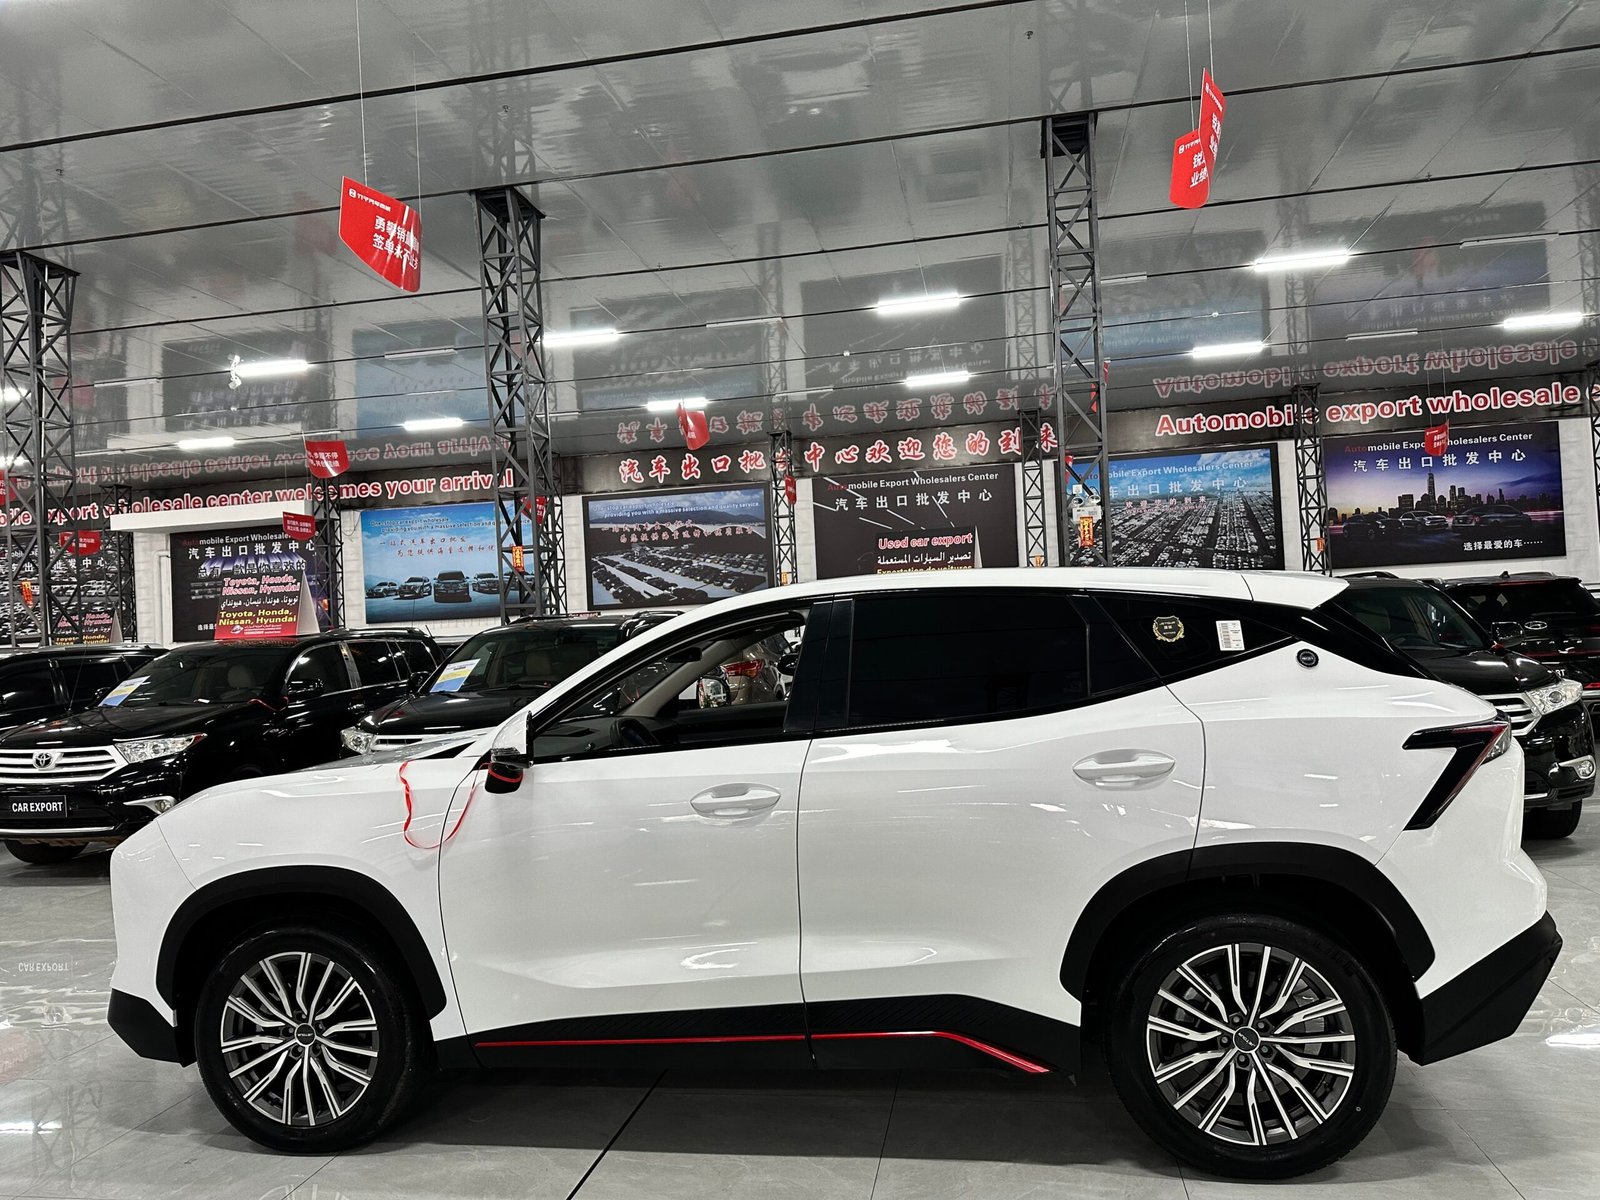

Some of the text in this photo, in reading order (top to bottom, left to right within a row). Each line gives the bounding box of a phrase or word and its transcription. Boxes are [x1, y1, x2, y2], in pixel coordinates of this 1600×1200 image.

[1326, 394, 1422, 424] export
[1425, 382, 1581, 415] wholesale
[1345, 441, 1401, 454] Automobile
[1402, 437, 1426, 451] Expo
[1447, 434, 1498, 446] holesalers
[1499, 432, 1533, 442] Center
[1353, 448, 1526, 473] 汽车出口批发中心
[1131, 467, 1162, 478] Export
[1163, 464, 1220, 475] Wholesalers
[1222, 461, 1254, 470] Center
[879, 478, 909, 489] Export
[911, 475, 966, 485] Wholesalers
[967, 472, 999, 481] Center
[207, 490, 273, 508] center
[386, 475, 435, 499] your
[835, 488, 993, 511] 汽车出口批发中心
[225, 535, 250, 545] Export
[878, 532, 973, 550] Used car export
[188, 541, 315, 560] 汽车出口批发中心
[222, 585, 258, 596] Nissan,
[259, 582, 301, 595] Hyundai
[223, 573, 297, 588] Toyota, Honda,
[218, 614, 297, 627] Nissan, Hyundai
[219, 608, 293, 619] Toyota, Honda,
[12, 801, 63, 813] CAR EXPORT
